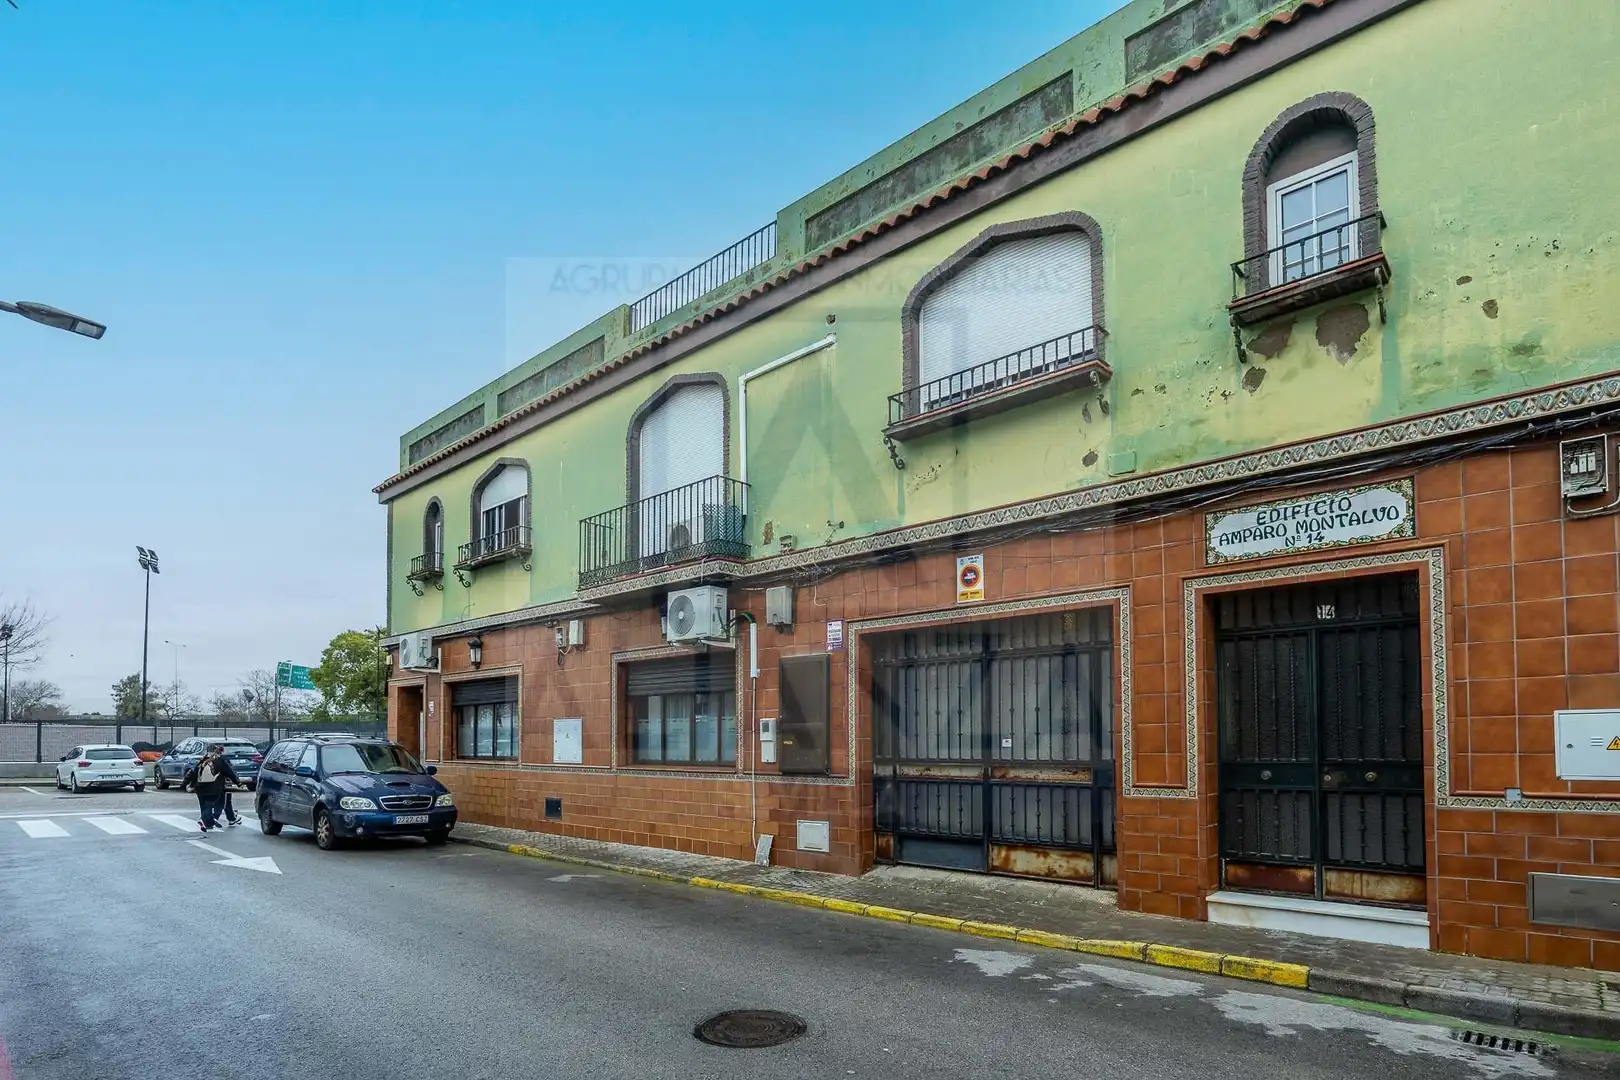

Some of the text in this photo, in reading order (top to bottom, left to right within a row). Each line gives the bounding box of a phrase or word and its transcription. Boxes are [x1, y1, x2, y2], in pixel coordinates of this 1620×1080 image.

[1256, 496, 1352, 526] EDIFICIO
[1219, 505, 1400, 546] AMPARO MONTALVO
[1306, 531, 1325, 544] 14
[1318, 604, 1335, 619] 14
